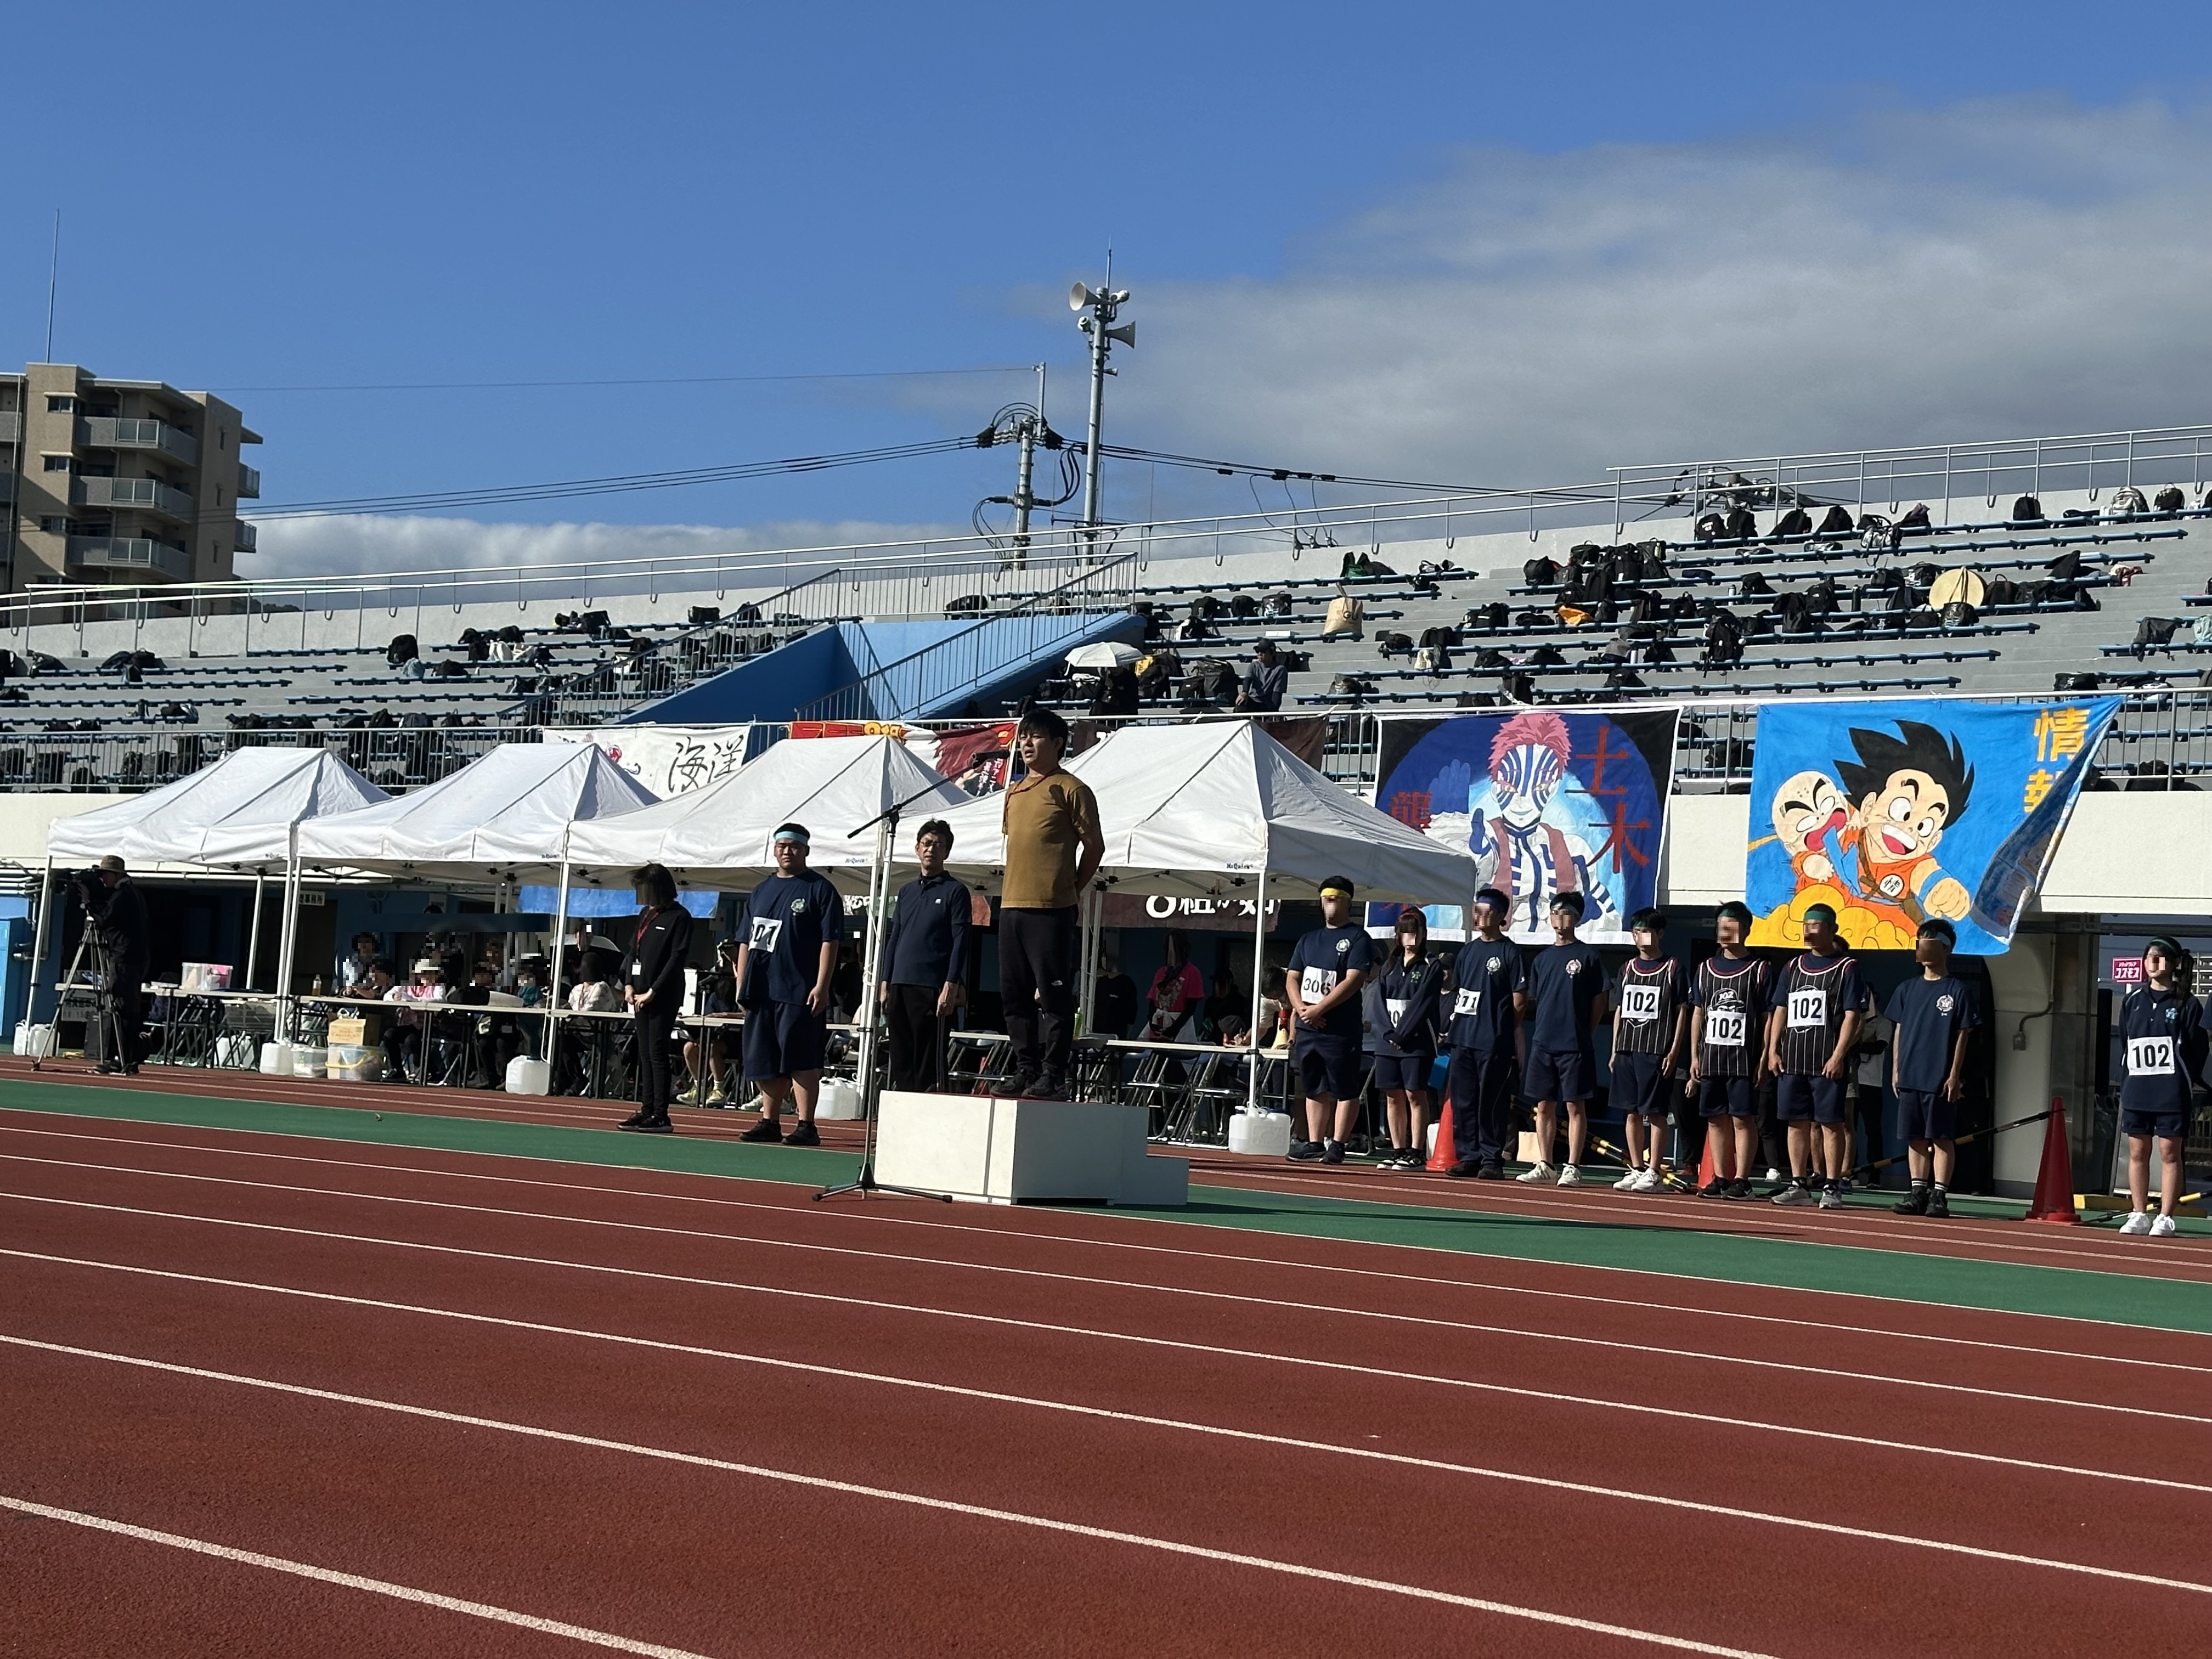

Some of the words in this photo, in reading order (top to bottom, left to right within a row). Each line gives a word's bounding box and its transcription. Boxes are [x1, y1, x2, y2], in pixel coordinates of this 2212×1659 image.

[668, 735, 744, 793] 海洋
[1564, 725, 1651, 874] 土木
[1304, 978, 1331, 996] 306
[1719, 991, 1734, 1001] 102
[1626, 991, 1655, 1012] 102
[1792, 997, 1822, 1020] 102
[1711, 1017, 1742, 1039] 102
[2132, 1044, 2170, 1068] 102
